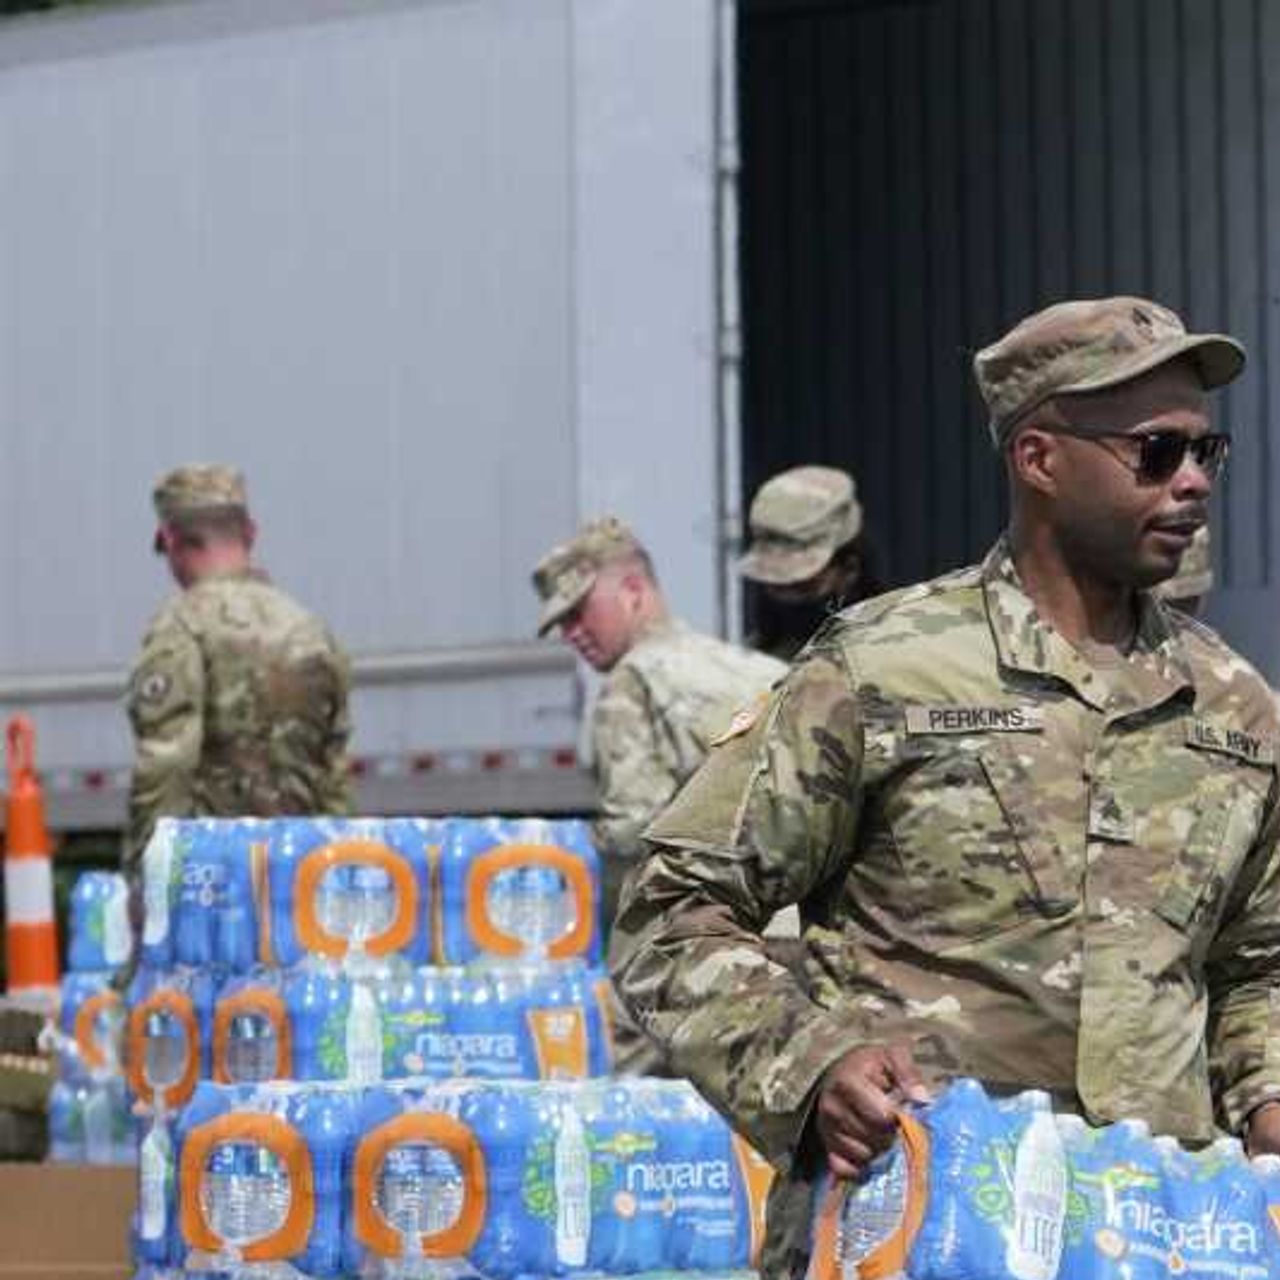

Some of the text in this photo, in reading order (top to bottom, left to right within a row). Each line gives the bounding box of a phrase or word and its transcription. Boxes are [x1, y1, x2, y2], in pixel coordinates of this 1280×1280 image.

[928, 708, 1025, 730] PERKINS
[626, 1160, 731, 1192] niagara
[1114, 1197, 1257, 1253] niagara
